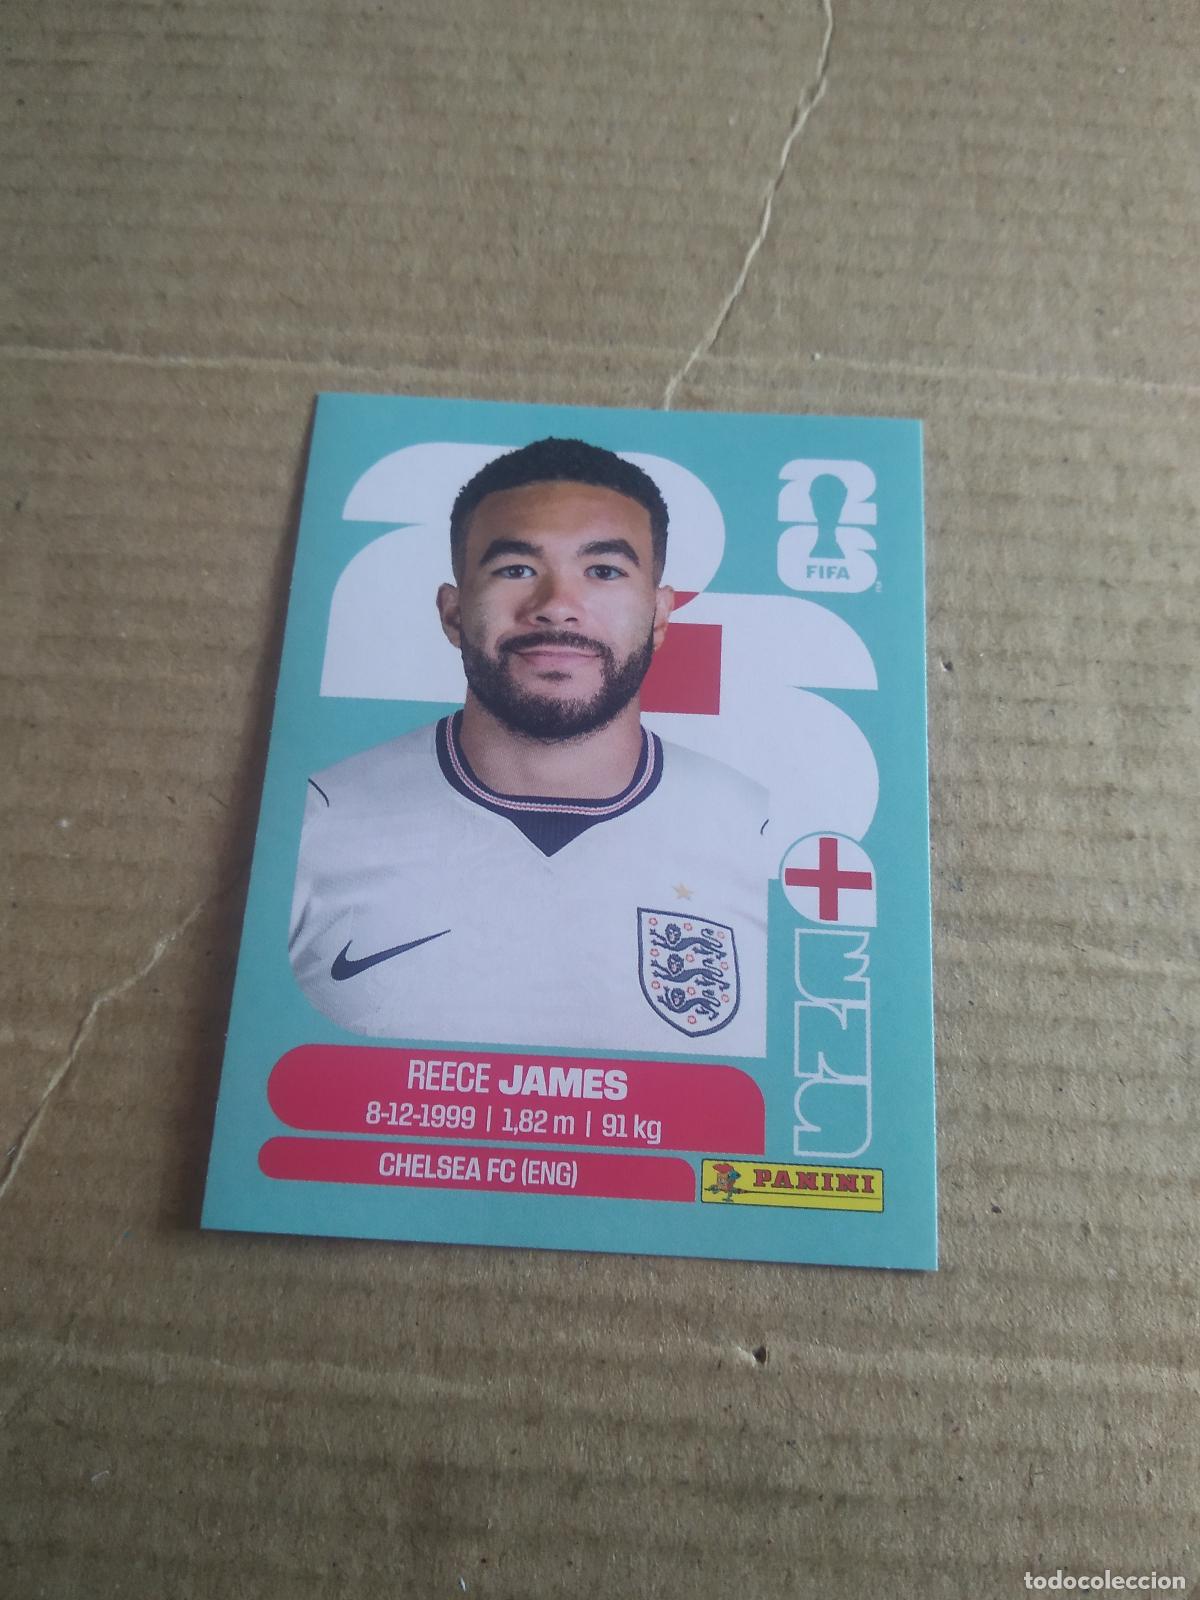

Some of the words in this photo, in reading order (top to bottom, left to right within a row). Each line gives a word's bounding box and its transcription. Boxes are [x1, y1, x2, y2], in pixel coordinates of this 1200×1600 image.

[806, 564, 850, 580] FIFA
[407, 1059, 491, 1093] REECE
[498, 1064, 628, 1101] JAMES
[365, 1100, 476, 1130] 8-12-1999
[502, 1108, 548, 1136] 1,82
[553, 1115, 575, 1135] m
[602, 1113, 628, 1138] 91
[633, 1114, 662, 1145] kg
[378, 1152, 481, 1181] CHELSEA
[486, 1158, 516, 1183] FC
[521, 1157, 578, 1189] (ENG)
[753, 1168, 875, 1194] PANINI
